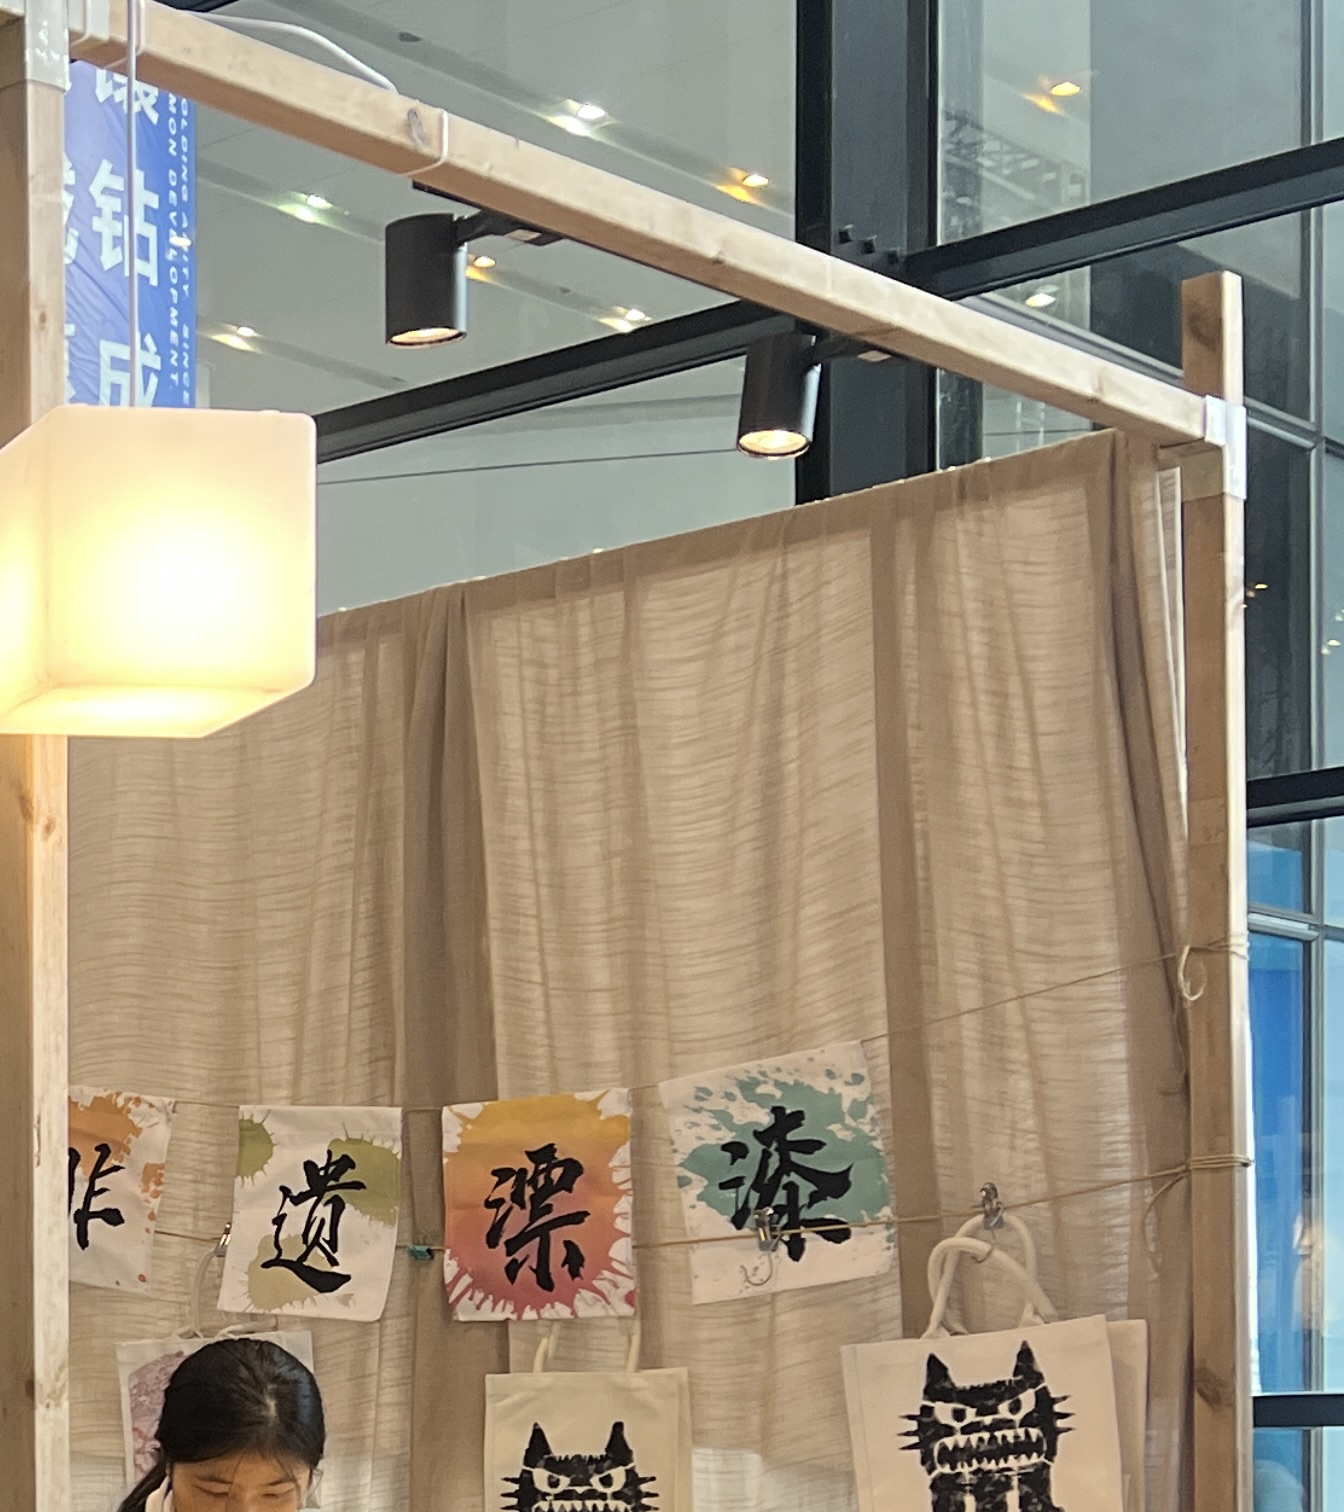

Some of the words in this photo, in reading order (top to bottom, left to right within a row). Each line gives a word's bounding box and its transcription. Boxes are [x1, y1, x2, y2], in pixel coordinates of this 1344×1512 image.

[260, 1147, 367, 1293] 遗
[482, 1141, 589, 1293] 漂
[717, 1104, 853, 1262] 漆
